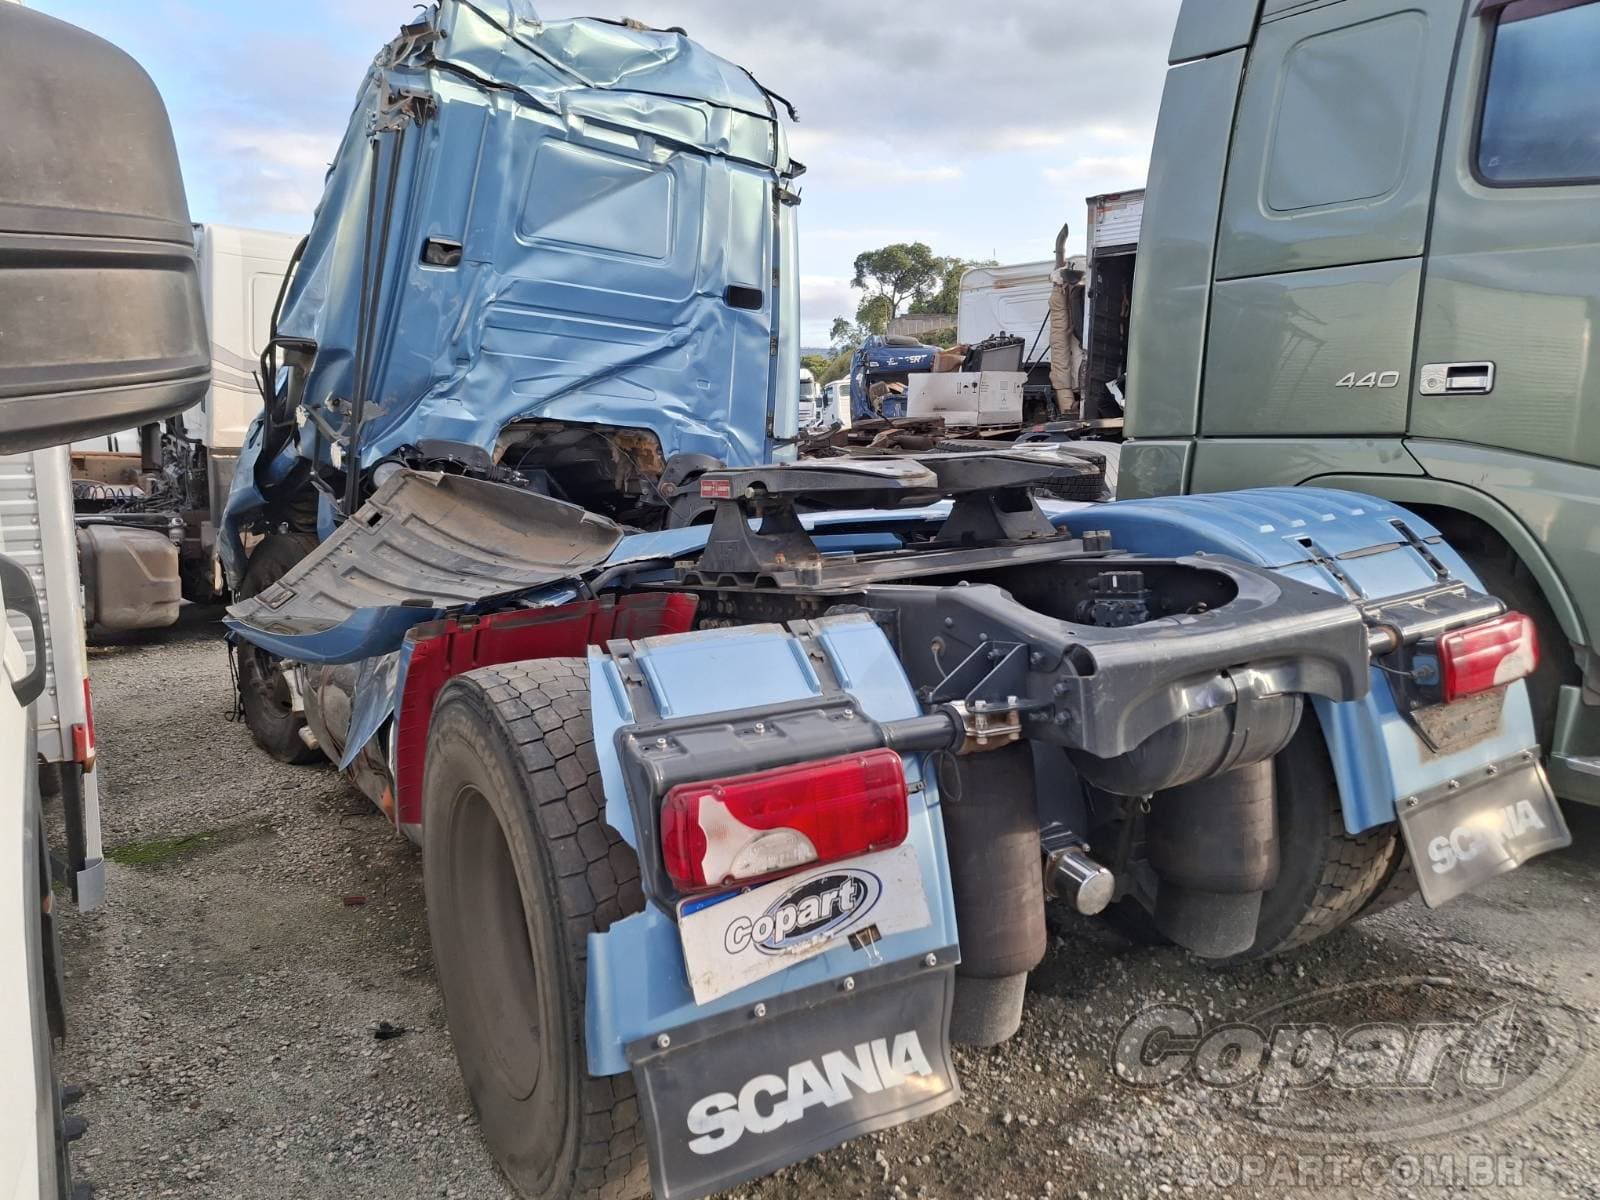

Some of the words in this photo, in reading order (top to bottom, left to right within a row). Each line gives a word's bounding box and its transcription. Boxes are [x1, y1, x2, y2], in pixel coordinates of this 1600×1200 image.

[1336, 371, 1399, 388] 440
[1428, 799, 1546, 874] SCNIA
[724, 875, 858, 955] Copart
[687, 1030, 932, 1155] SCANIA
